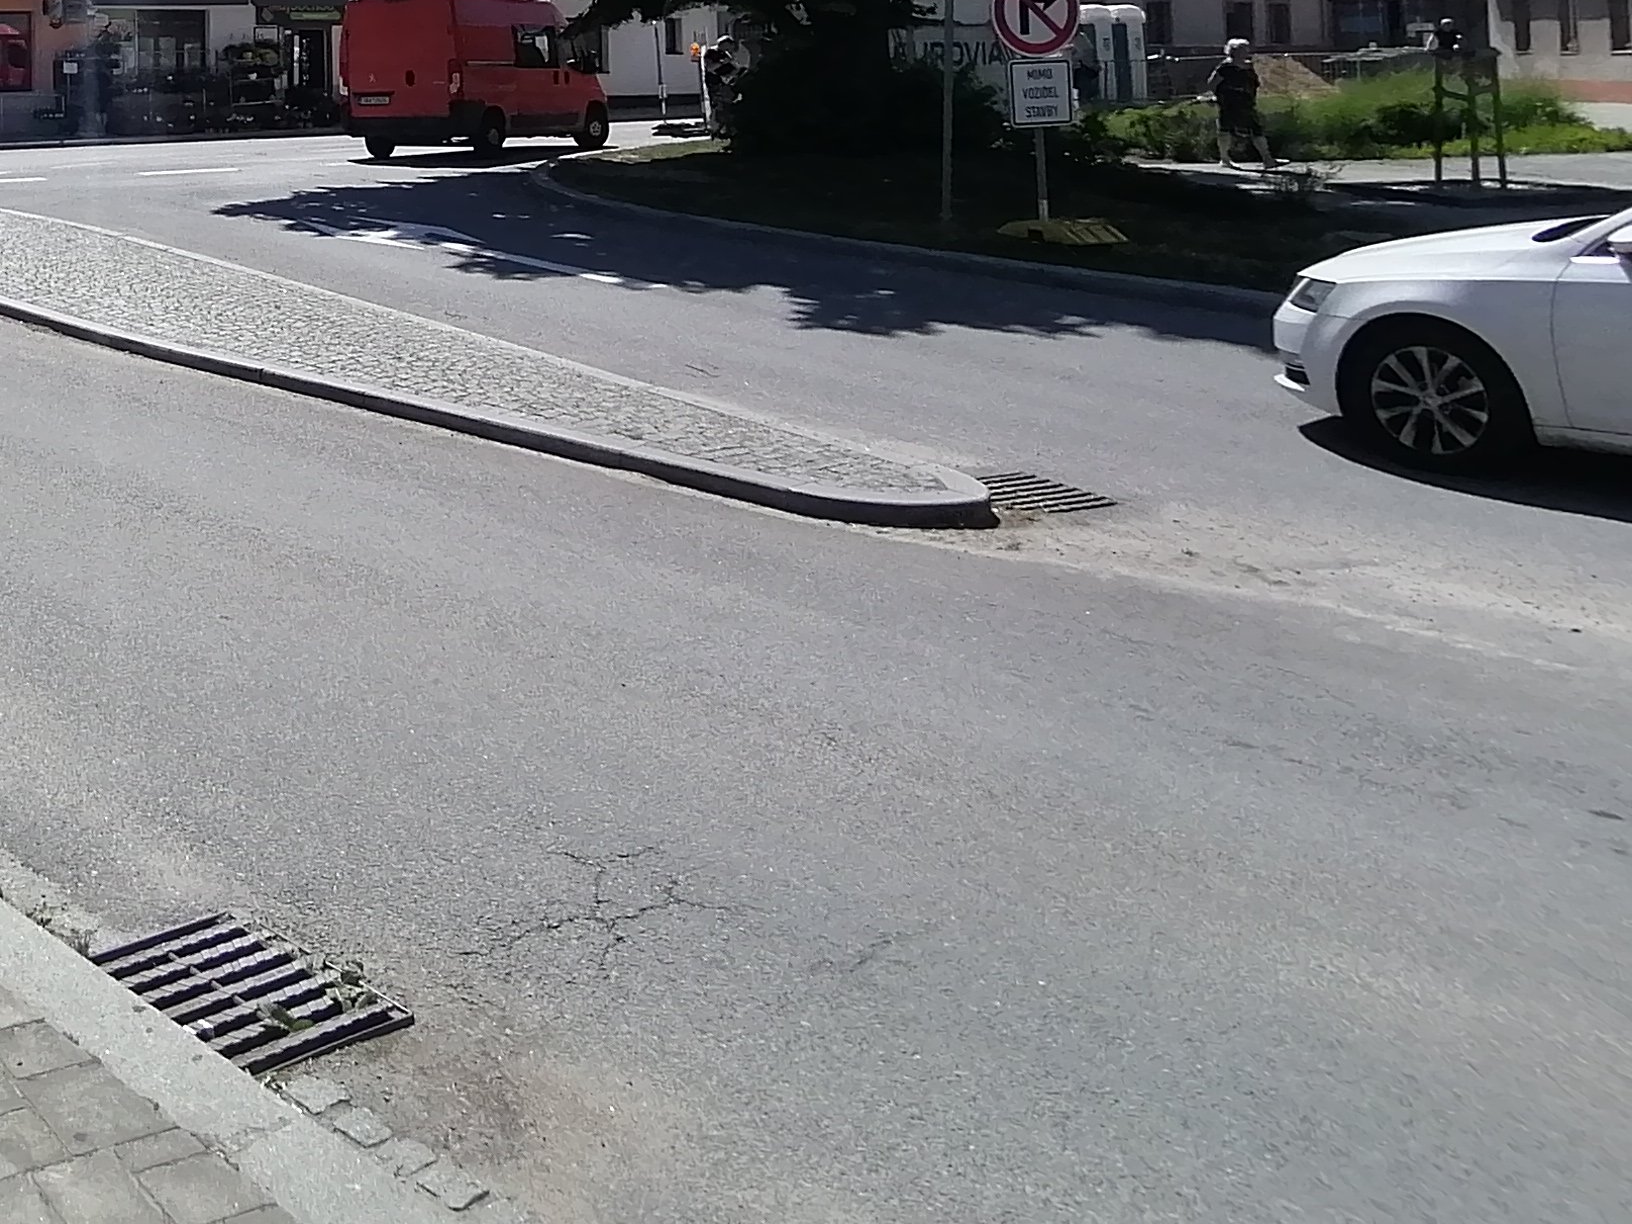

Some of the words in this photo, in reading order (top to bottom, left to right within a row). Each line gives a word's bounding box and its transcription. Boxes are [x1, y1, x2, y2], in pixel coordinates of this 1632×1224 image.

[1026, 68, 1054, 80] MIMO
[1021, 86, 1059, 100] VOZIDEL
[1025, 104, 1059, 118] STAVBY
